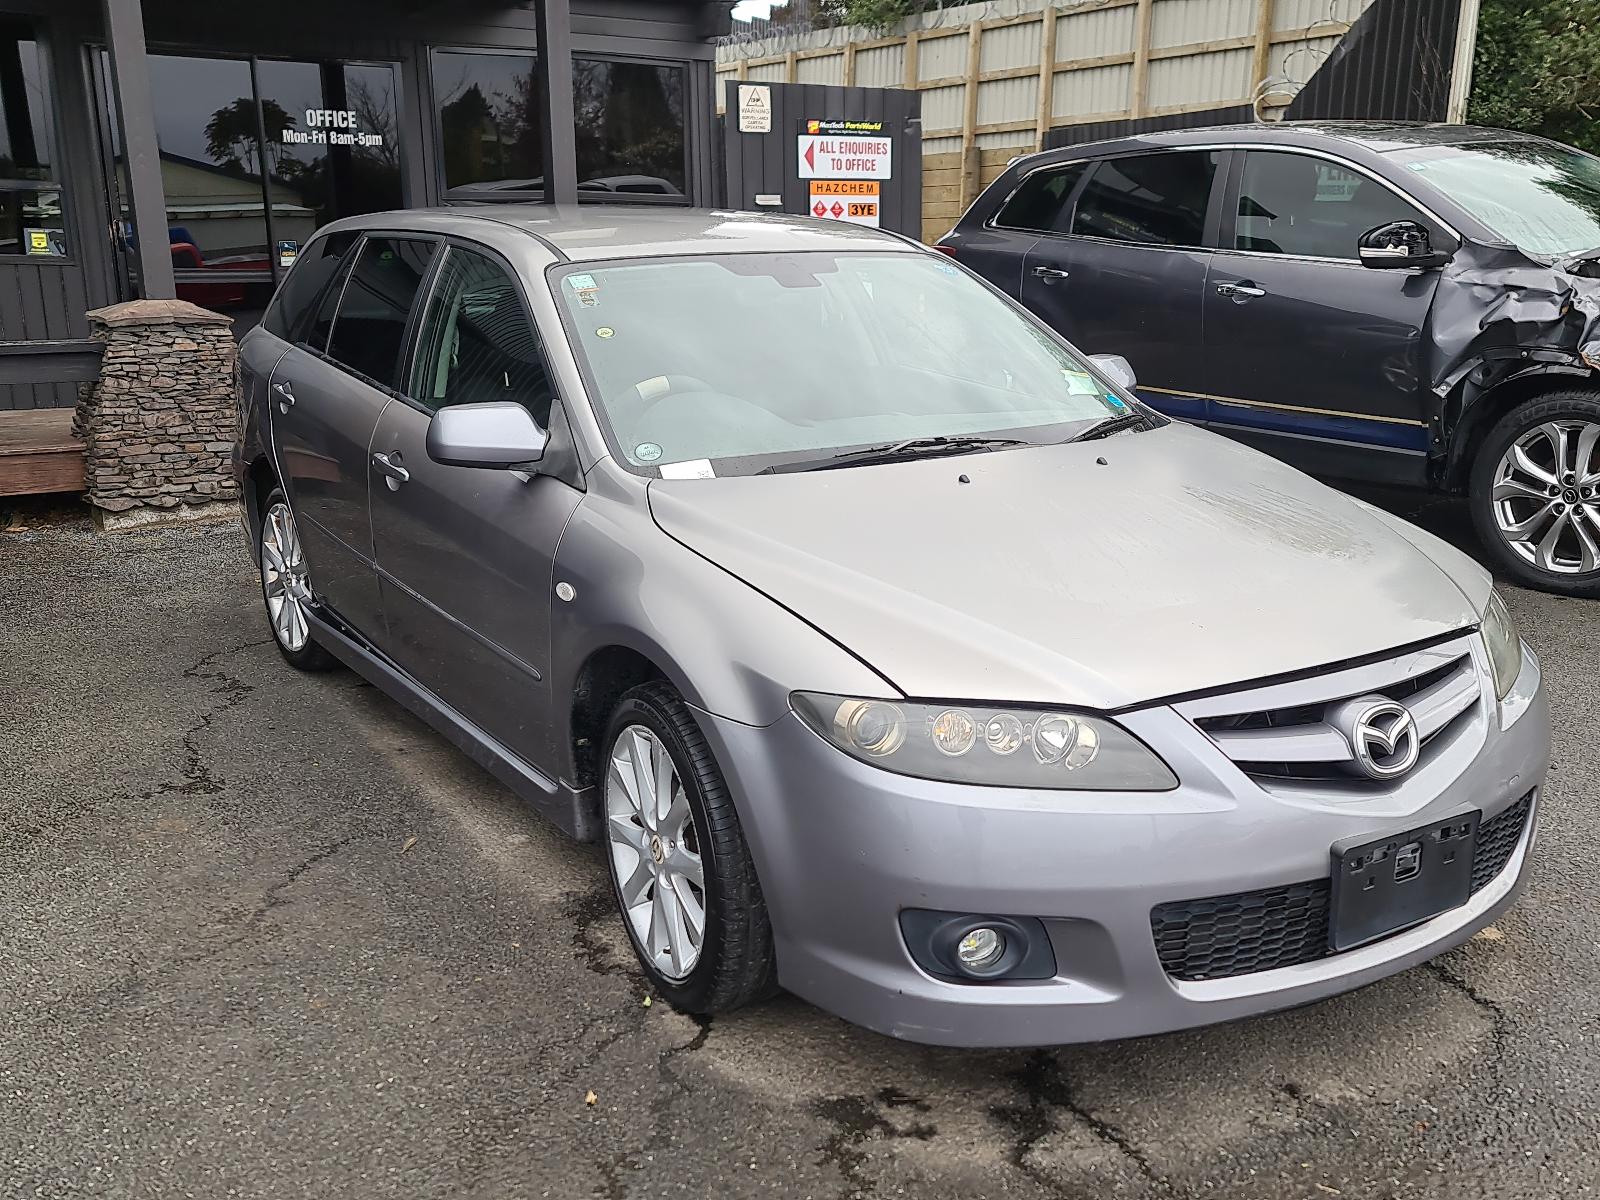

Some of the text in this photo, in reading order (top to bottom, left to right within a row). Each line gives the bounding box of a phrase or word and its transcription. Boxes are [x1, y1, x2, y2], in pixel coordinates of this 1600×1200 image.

[305, 109, 358, 128] OFFICE
[282, 129, 383, 147] Mon-Fri 8am-5pm
[819, 141, 888, 155] ALL ENQUIRIES
[831, 158, 876, 171] TO OFFICE
[816, 183, 874, 193] HAZCHEM
[851, 204, 874, 216] 3YE
